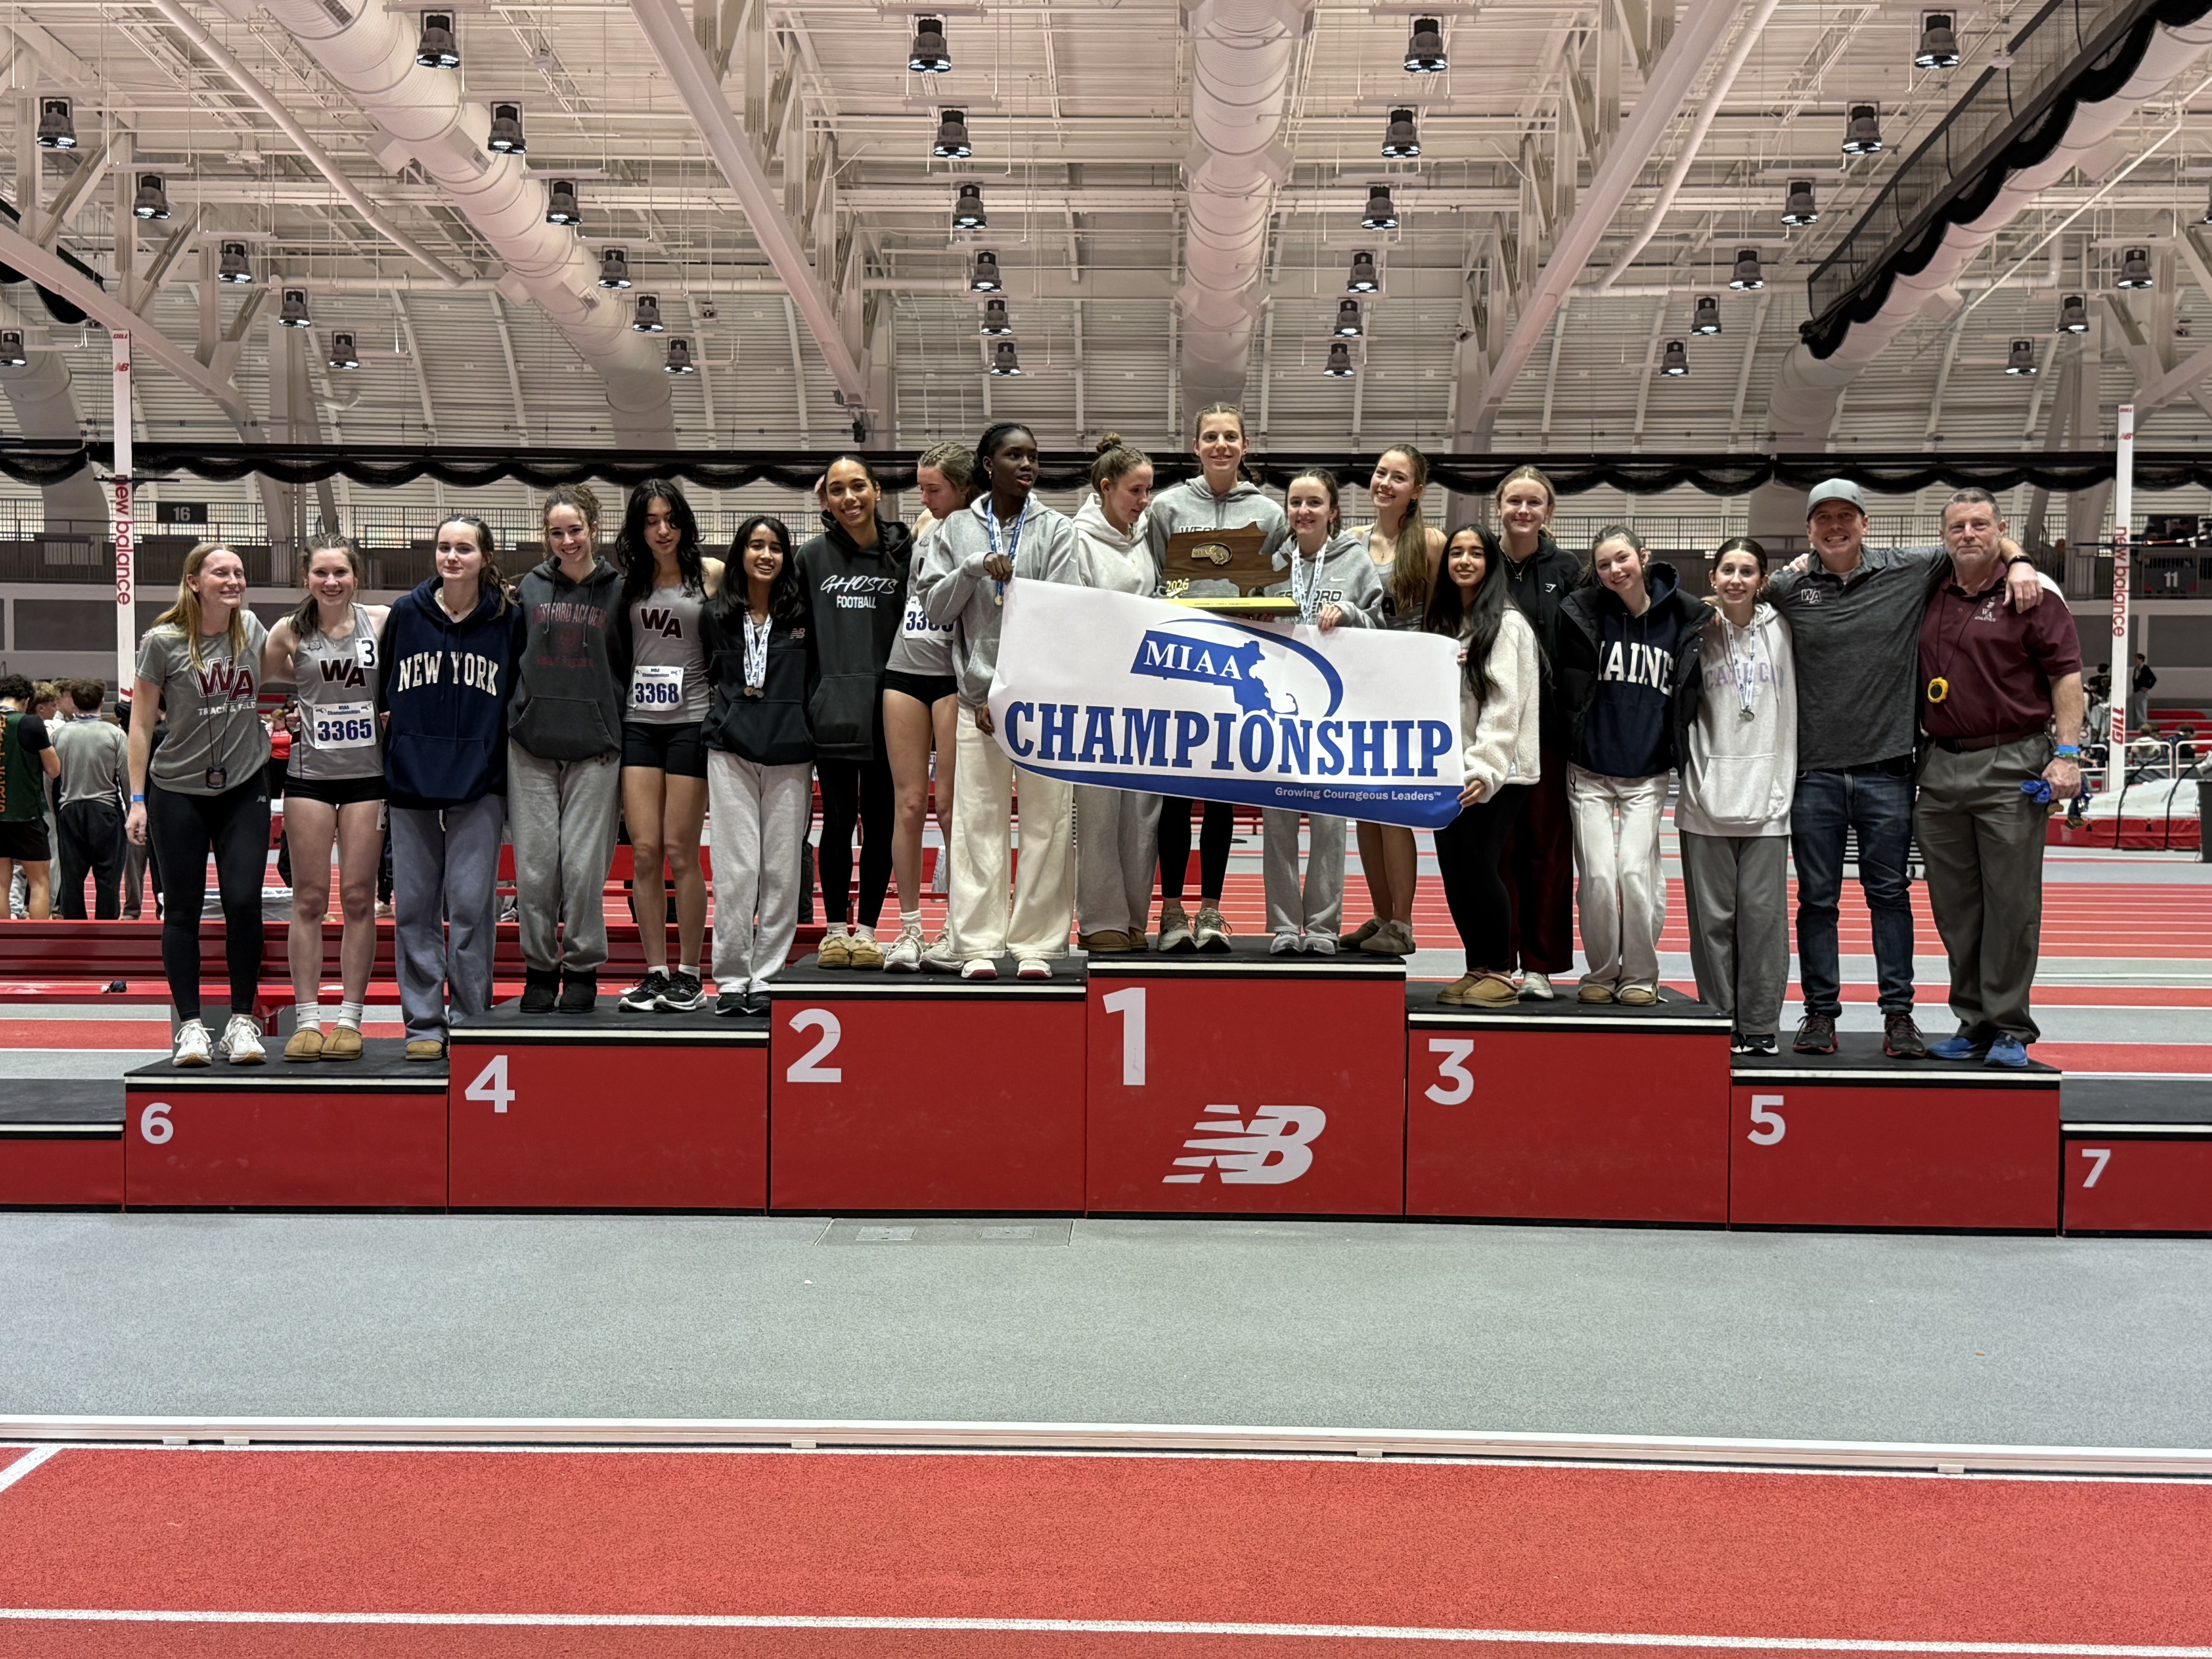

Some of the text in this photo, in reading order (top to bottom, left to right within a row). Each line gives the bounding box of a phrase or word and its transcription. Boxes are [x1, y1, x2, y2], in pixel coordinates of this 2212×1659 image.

[173, 507, 191, 521] 16
[116, 521, 134, 605] balance
[2112, 526, 2131, 637] new balance
[2164, 571, 2178, 588] 11
[820, 575, 898, 594] GHOSTS
[836, 595, 877, 609] FOOTBALL
[1165, 578, 1189, 592] 2026
[1801, 588, 1821, 604] WA
[639, 607, 684, 640] WA
[789, 628, 805, 639] NB
[362, 640, 375, 667] 3
[1143, 639, 1243, 680] MIAA
[1597, 640, 1674, 698] AINE
[193, 656, 256, 704] WA
[318, 657, 368, 690] WA
[397, 651, 499, 696] NEW YORK
[635, 682, 679, 704] 3368
[318, 718, 372, 741] 3365
[1005, 702, 1452, 776] CHAMPIONSHIP
[2112, 707, 2124, 745] GILL
[1275, 787, 1320, 800] Growing
[1323, 789, 1389, 802] Courageous
[787, 1008, 842, 1083] 2
[1103, 987, 1146, 1085] 1
[465, 1055, 515, 1113] 4
[1424, 1039, 1474, 1105] 3
[141, 1103, 173, 1144] 6
[1747, 1095, 1786, 1146] 5
[1162, 1104, 1326, 1184] NB
[2082, 1149, 2111, 1187] 7
